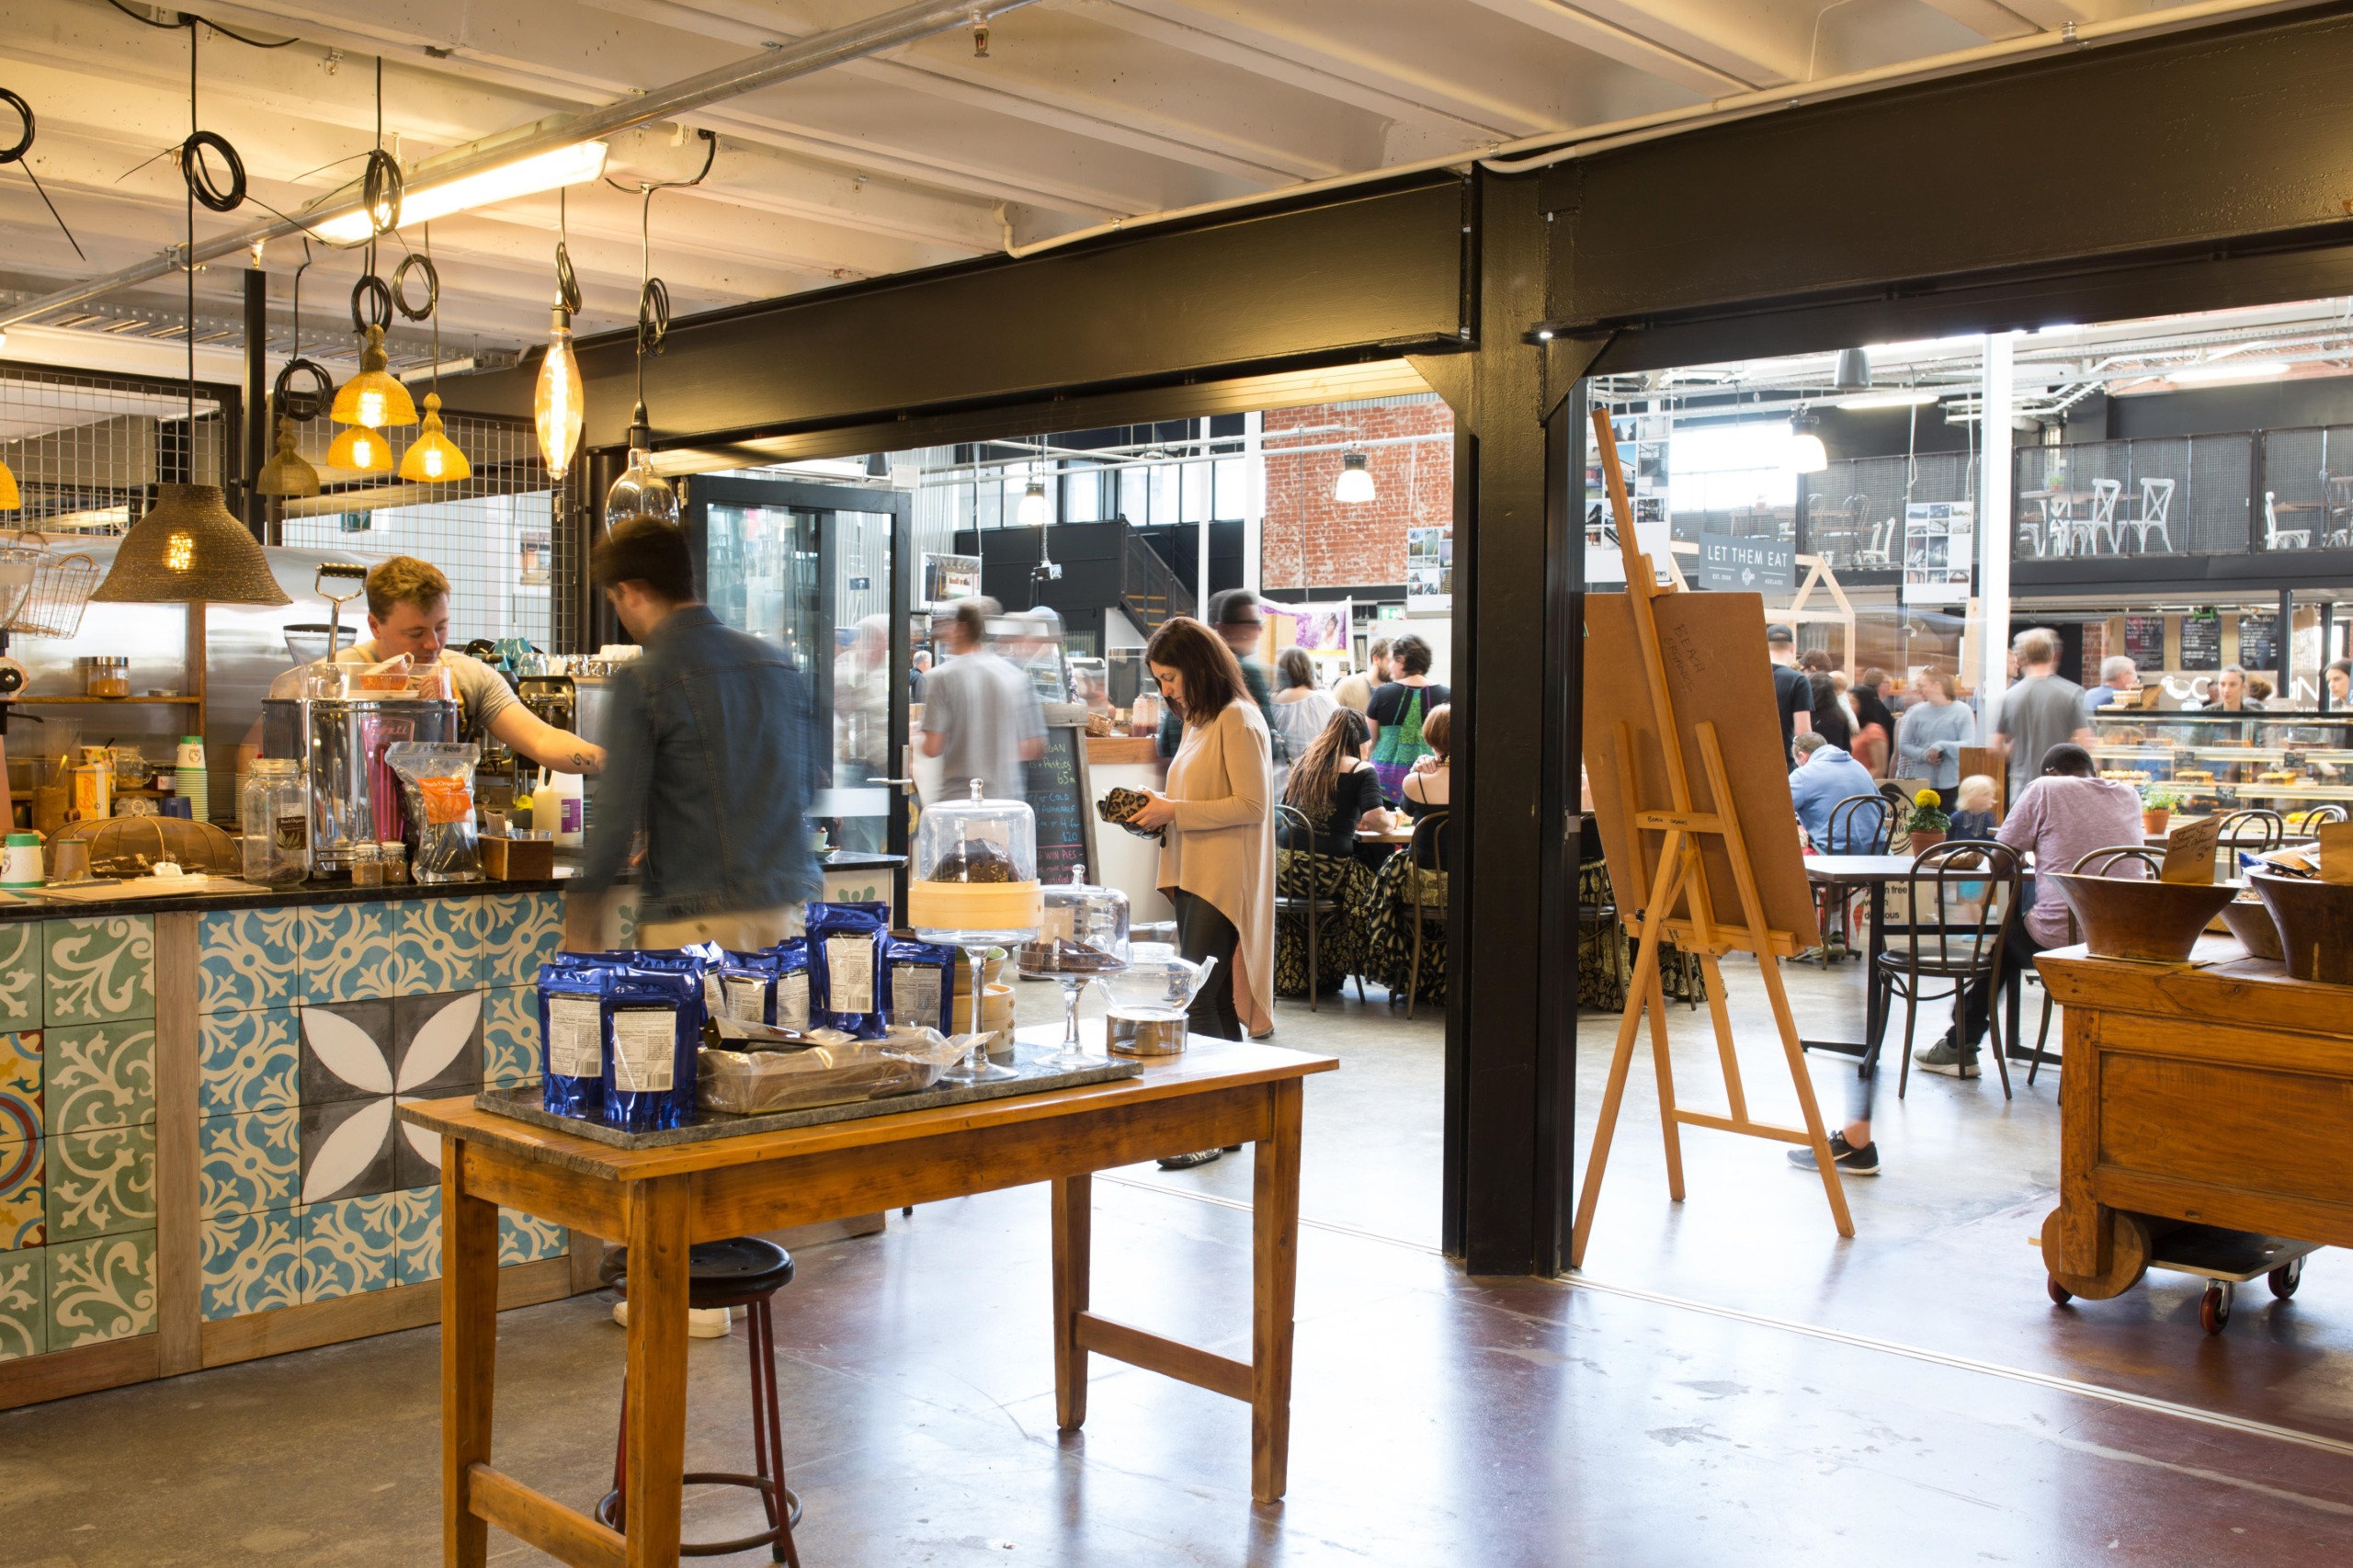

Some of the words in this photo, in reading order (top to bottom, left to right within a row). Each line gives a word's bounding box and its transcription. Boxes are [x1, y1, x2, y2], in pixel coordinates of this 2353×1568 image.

[1708, 545, 1727, 562] LET
[1732, 547, 1763, 565] THEM
[1768, 551, 1788, 568] EAT
[1673, 623, 1706, 673] BEACH
[1050, 793, 1069, 801] COLD
[1061, 817, 1067, 829] 4
[1062, 849, 1076, 859] PIES
[1892, 885, 1907, 894] free
